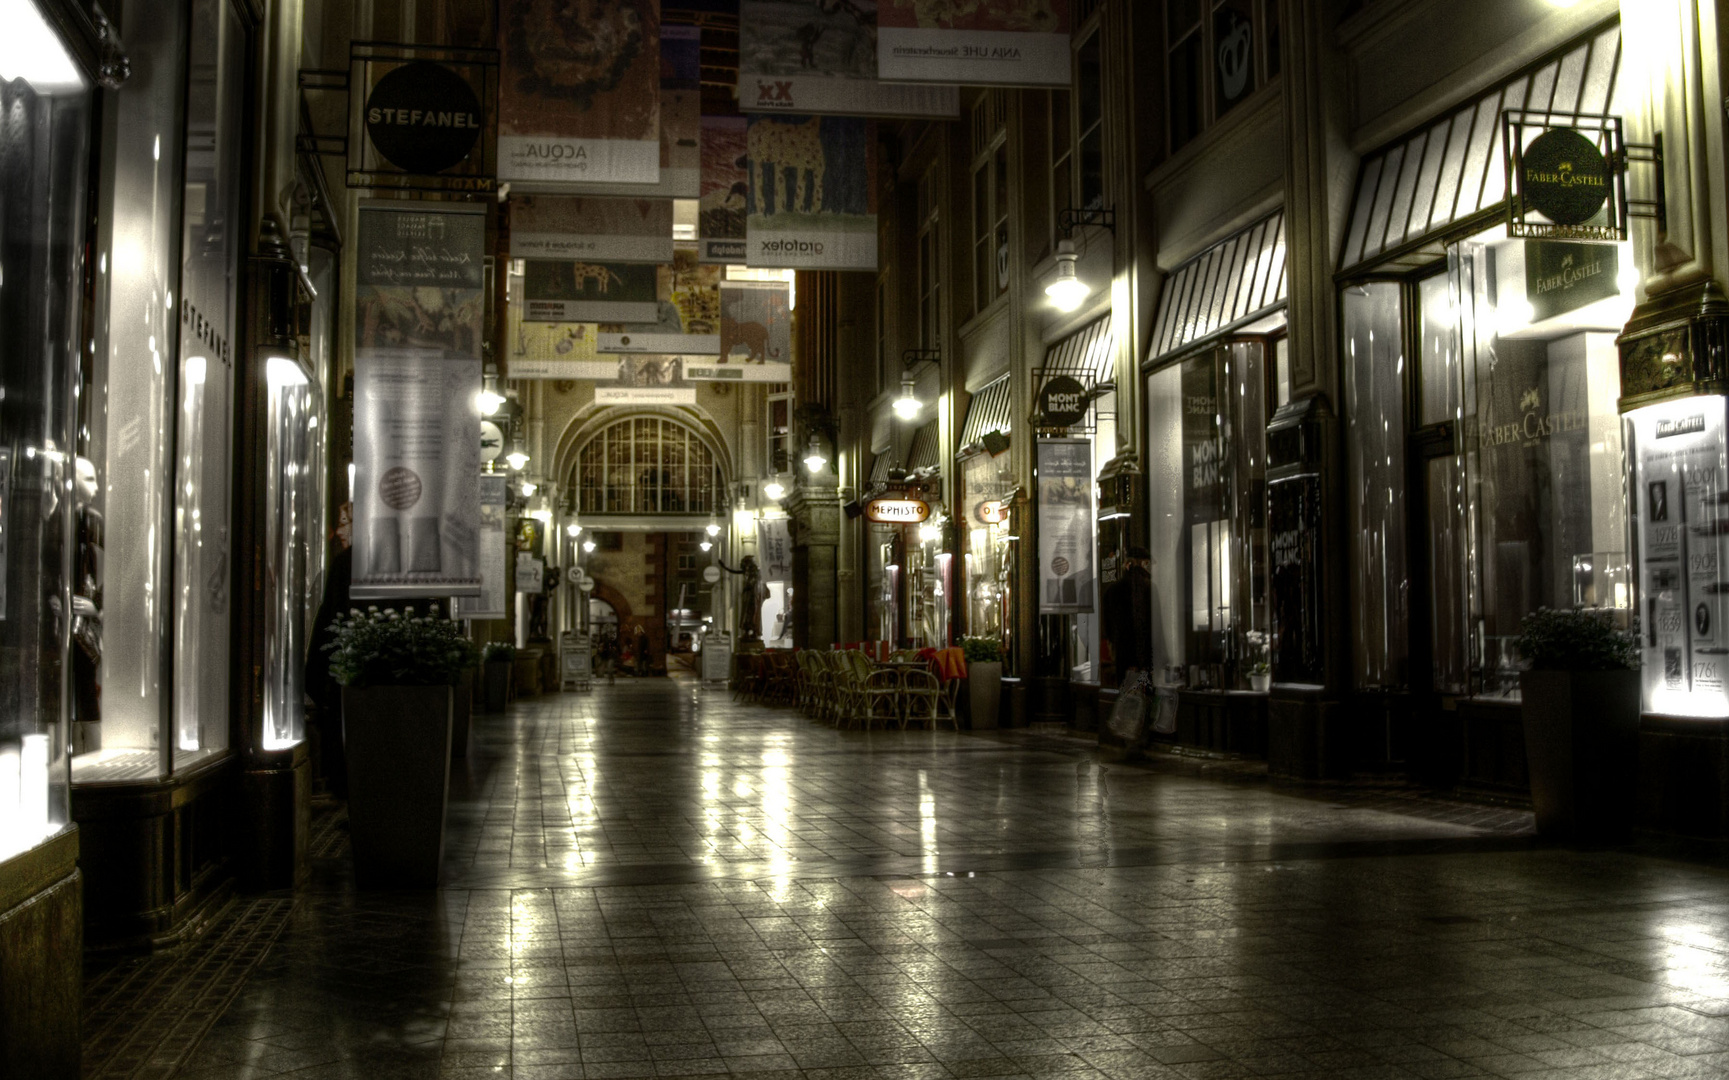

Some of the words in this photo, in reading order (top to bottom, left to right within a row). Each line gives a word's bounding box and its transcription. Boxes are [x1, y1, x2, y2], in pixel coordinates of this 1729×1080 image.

[368, 106, 479, 129] STEFANEL
[1525, 167, 1605, 187] FABER-CASTELL
[183, 299, 231, 369] STEFANEL
[1047, 392, 1080, 403] MONT
[1048, 403, 1080, 413] BLANC
[1479, 411, 1586, 448] FABER-CASTELL
[1686, 467, 1715, 485] 2001
[872, 505, 924, 516] MEPHISTO
[1655, 526, 1678, 543] 1978
[1693, 661, 1717, 678] 1761
